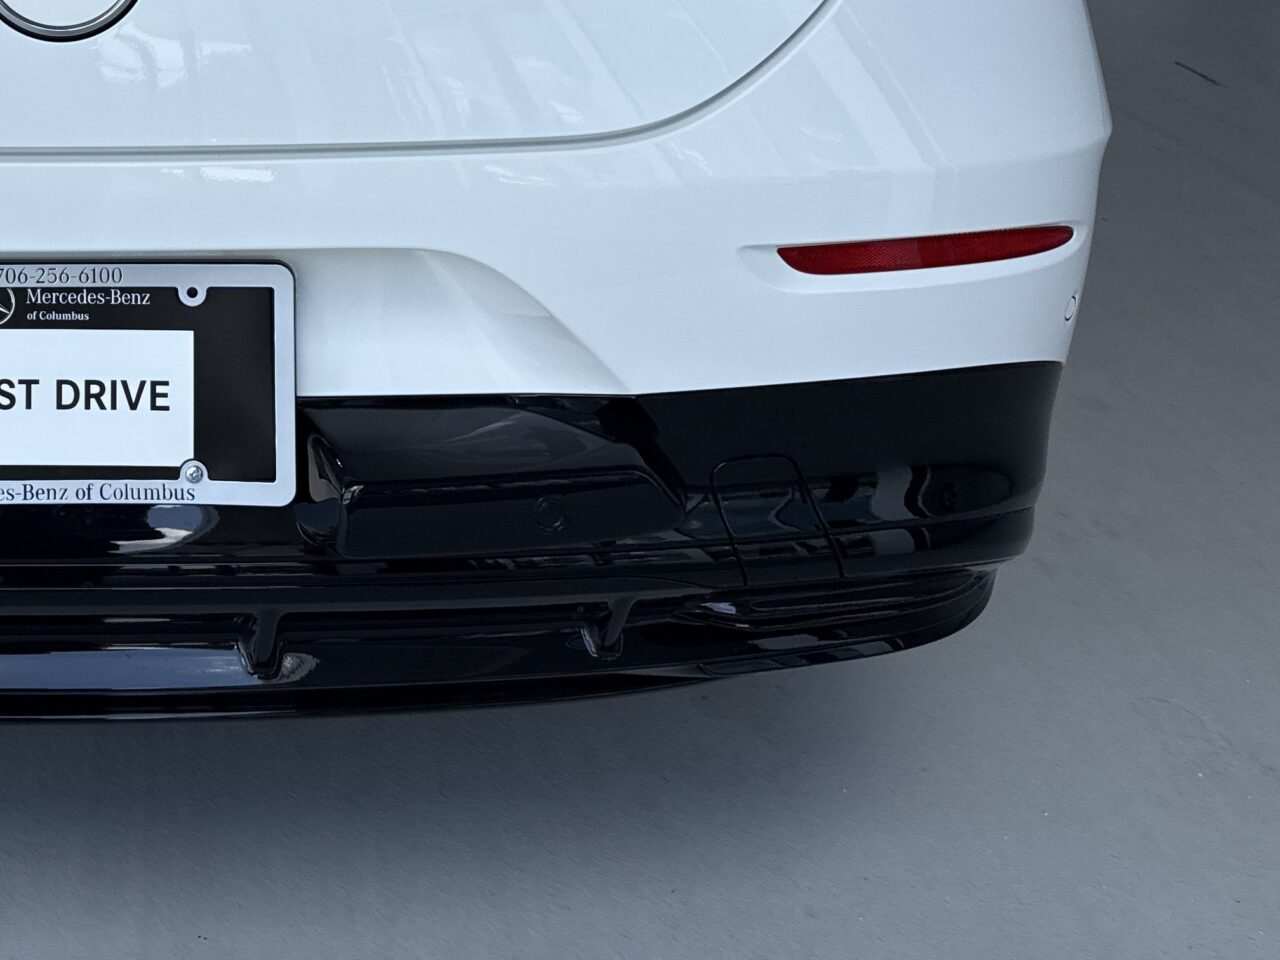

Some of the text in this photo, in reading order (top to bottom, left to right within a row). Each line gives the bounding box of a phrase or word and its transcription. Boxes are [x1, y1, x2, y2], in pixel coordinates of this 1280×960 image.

[25, 289, 151, 305] Mercedes-Benz
[26, 311, 90, 321] of Columbus
[55, 379, 171, 412] DRIVE
[75, 483, 93, 501] of
[99, 482, 196, 501] Columbus
